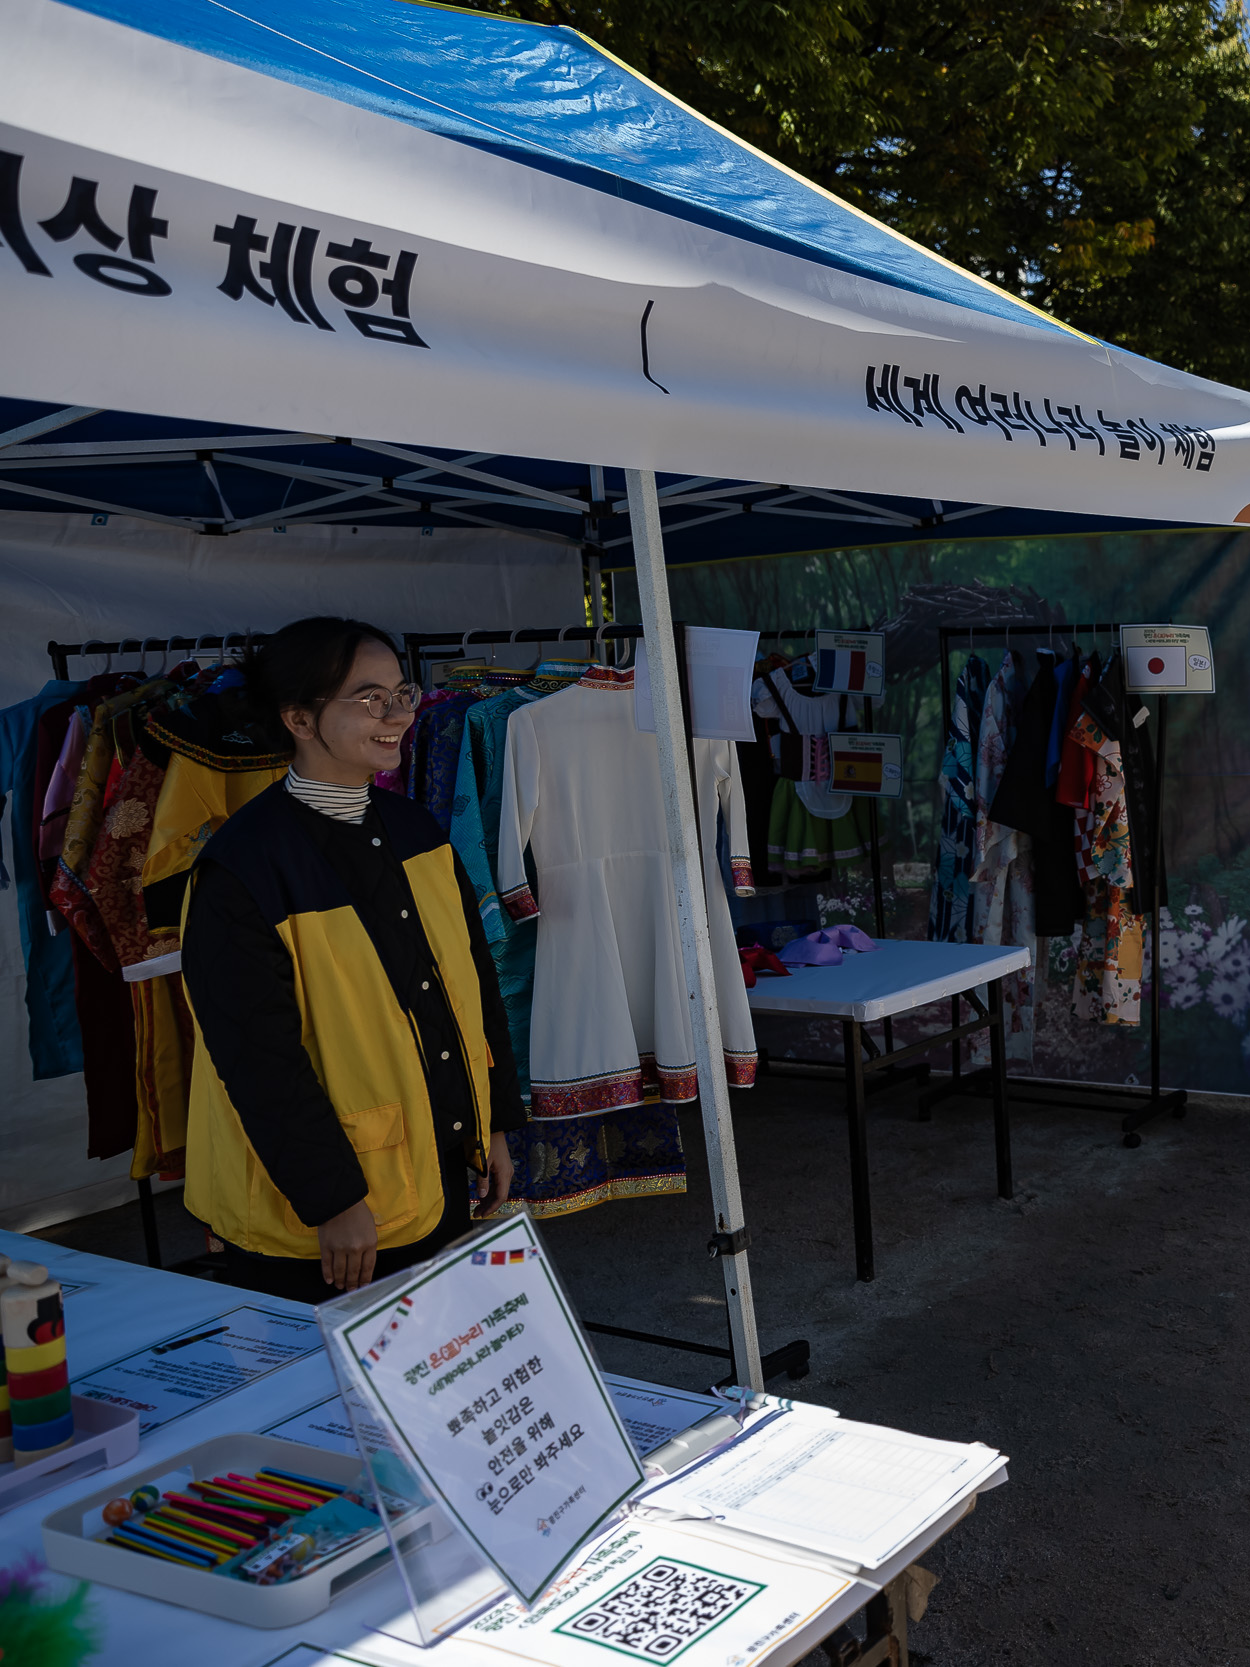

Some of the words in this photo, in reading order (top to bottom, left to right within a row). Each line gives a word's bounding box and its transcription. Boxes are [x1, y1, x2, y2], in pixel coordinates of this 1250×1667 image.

[212, 213, 432, 350] 체험
[865, 363, 964, 434] 세계
[955, 383, 1106, 456] 여러나라
[1096, 409, 1166, 466] 놀이
[1159, 421, 1217, 473] 체험
[403, 1361, 430, 1385] 광진
[485, 1292, 529, 1332] 가족축제
[446, 1388, 502, 1437] 뾰족하고
[502, 1355, 543, 1394] 위험한
[481, 1396, 535, 1446] 놀잇감은
[487, 1468, 536, 1516] 눈으로만
[533, 1422, 585, 1471] 봐주세요
[488, 1435, 530, 1476] 안전을
[527, 1411, 556, 1442] 위해
[548, 1484, 587, 1526] 광진구가족센터
[483, 1609, 519, 1632] 광진
[584, 1530, 641, 1566] 가족축제
